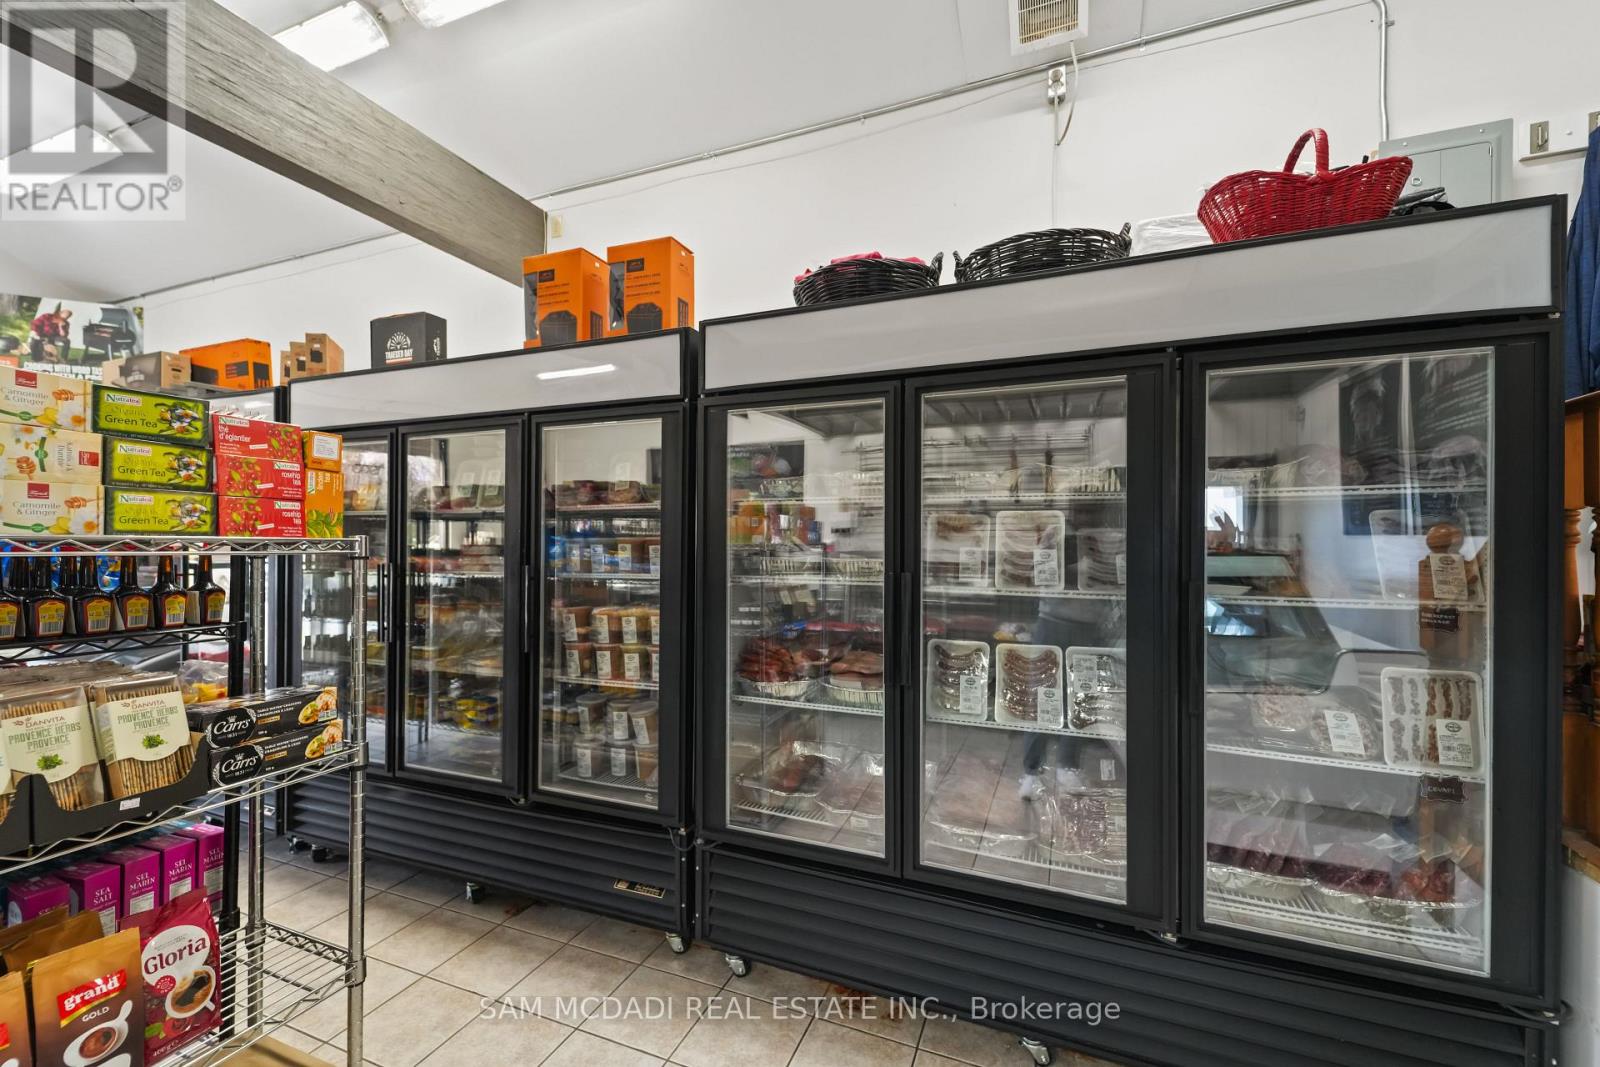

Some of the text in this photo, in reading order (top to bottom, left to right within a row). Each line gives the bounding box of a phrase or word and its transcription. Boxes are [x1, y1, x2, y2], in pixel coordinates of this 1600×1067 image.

[12, 395, 44, 406] Ginger
[104, 414, 158, 429] Green Tea
[117, 465, 166, 477] Green Tea
[12, 501, 62, 510] Camomile
[25, 509, 57, 517] Ginger
[119, 516, 169, 525] Green Tea
[132, 699, 166, 710] DANVITA
[117, 710, 154, 724] PROVENCE
[156, 706, 179, 716] HERBS
[25, 715, 65, 728] DANVITA
[133, 716, 170, 730] PROVENCE
[8, 727, 52, 745] PROVENCE
[55, 721, 81, 734] HERBS
[26, 734, 71, 750] PROVENCE
[174, 859, 186, 867] SEL
[169, 863, 192, 877] MARIN
[136, 872, 149, 881] SEL
[129, 876, 155, 890] MARIN
[95, 886, 111, 897] SEA
[93, 893, 113, 905] SALT
[143, 937, 207, 975] Gloria
[82, 1006, 110, 1022] GOLD
